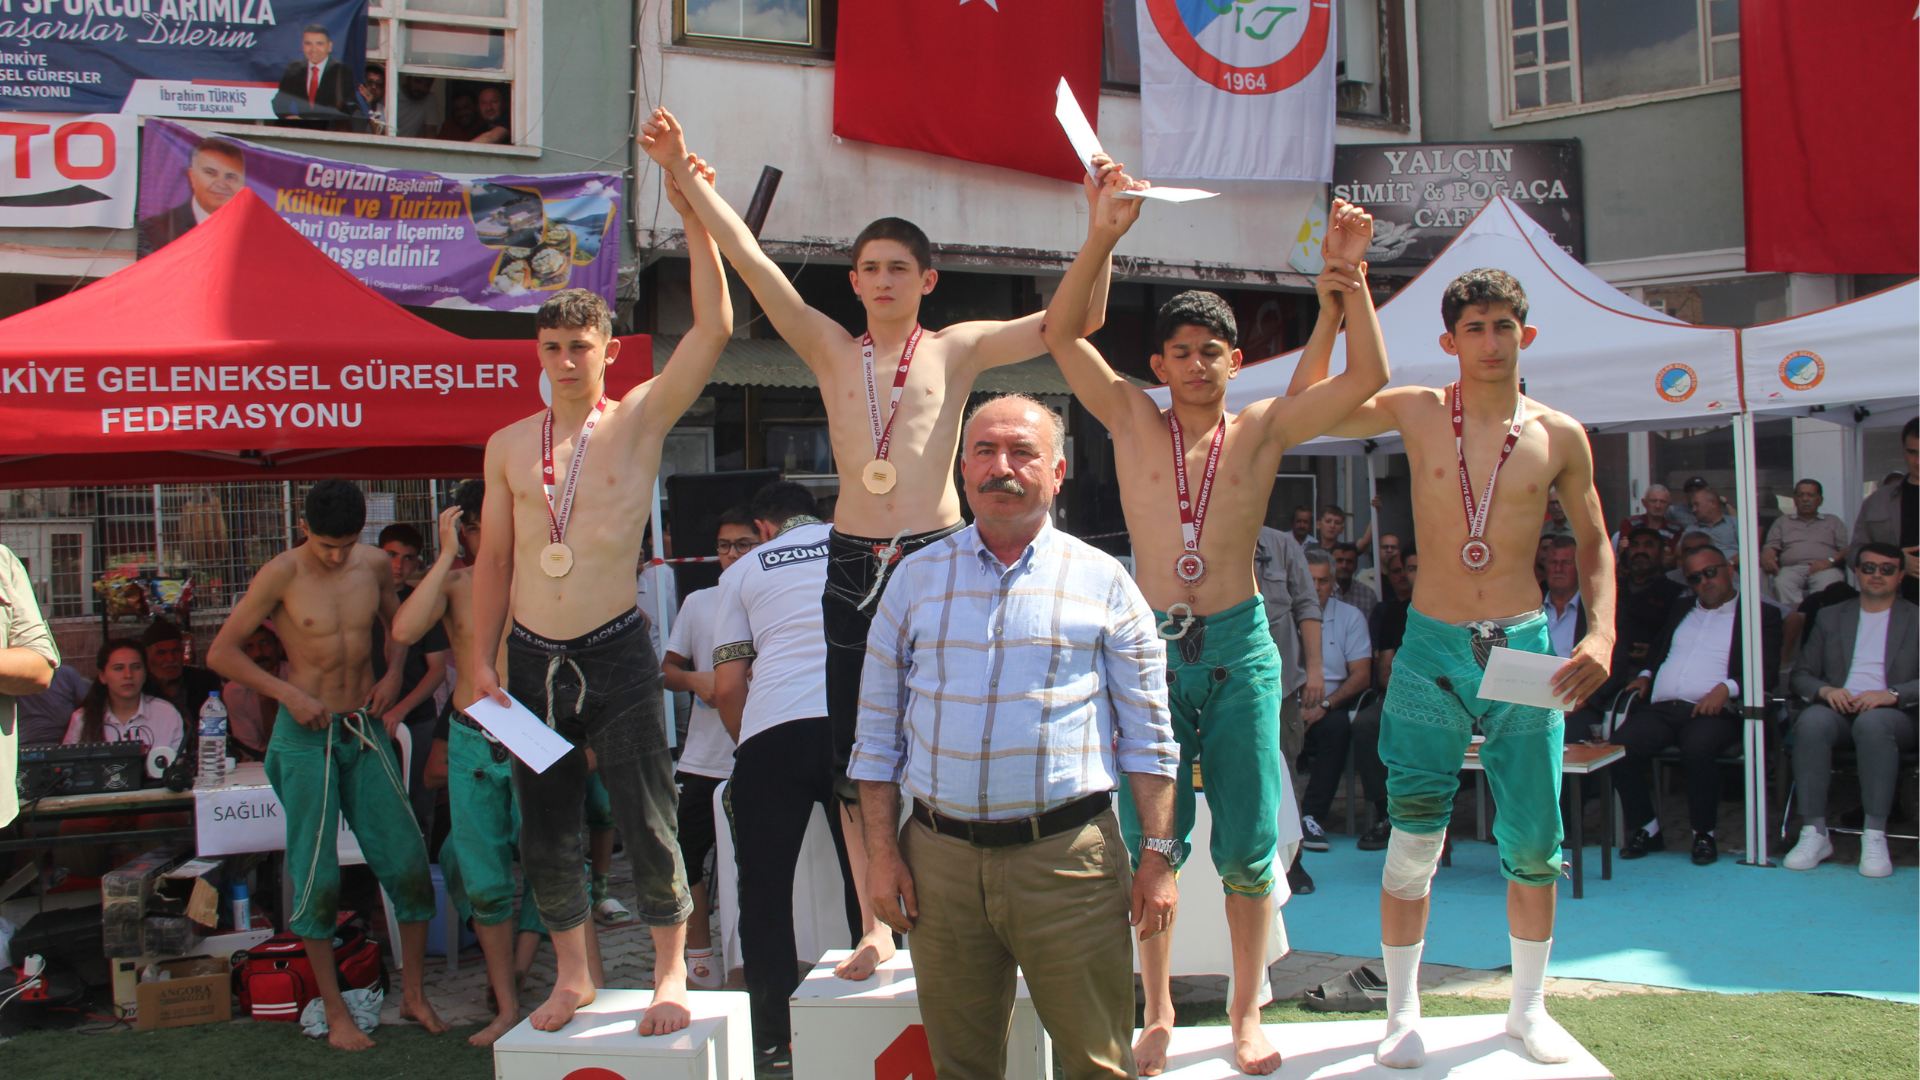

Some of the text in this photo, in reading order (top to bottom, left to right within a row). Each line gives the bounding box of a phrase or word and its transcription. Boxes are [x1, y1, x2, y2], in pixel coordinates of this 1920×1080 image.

[137, 12, 257, 48] Dilerim
[26, 68, 102, 84] GÜREŞLER
[1223, 72, 1267, 90] 1964
[160, 85, 247, 104] İbrahim TÜRKİŞ
[200, 103, 234, 114] BAŞKANI
[1384, 148, 1514, 178] YALÇIN
[387, 178, 443, 195] Başkenti
[1334, 176, 1569, 204] SİMİT & POĞAÇA
[275, 188, 462, 219] Kültür ve Turizm
[328, 221, 392, 243] Oğuzlar
[396, 220, 464, 243] İlçemize
[97, 366, 330, 393] GELENEKSEL
[340, 359, 519, 395] GÜREŞLER
[102, 402, 362, 434] FEDERASYONU
[576, 433, 589, 458] TÜRKİYE
[566, 458, 580, 496] GELENEKSEL
[1178, 467, 1186, 494] TÜRKİYE
[214, 801, 277, 822] SAĞLIK
